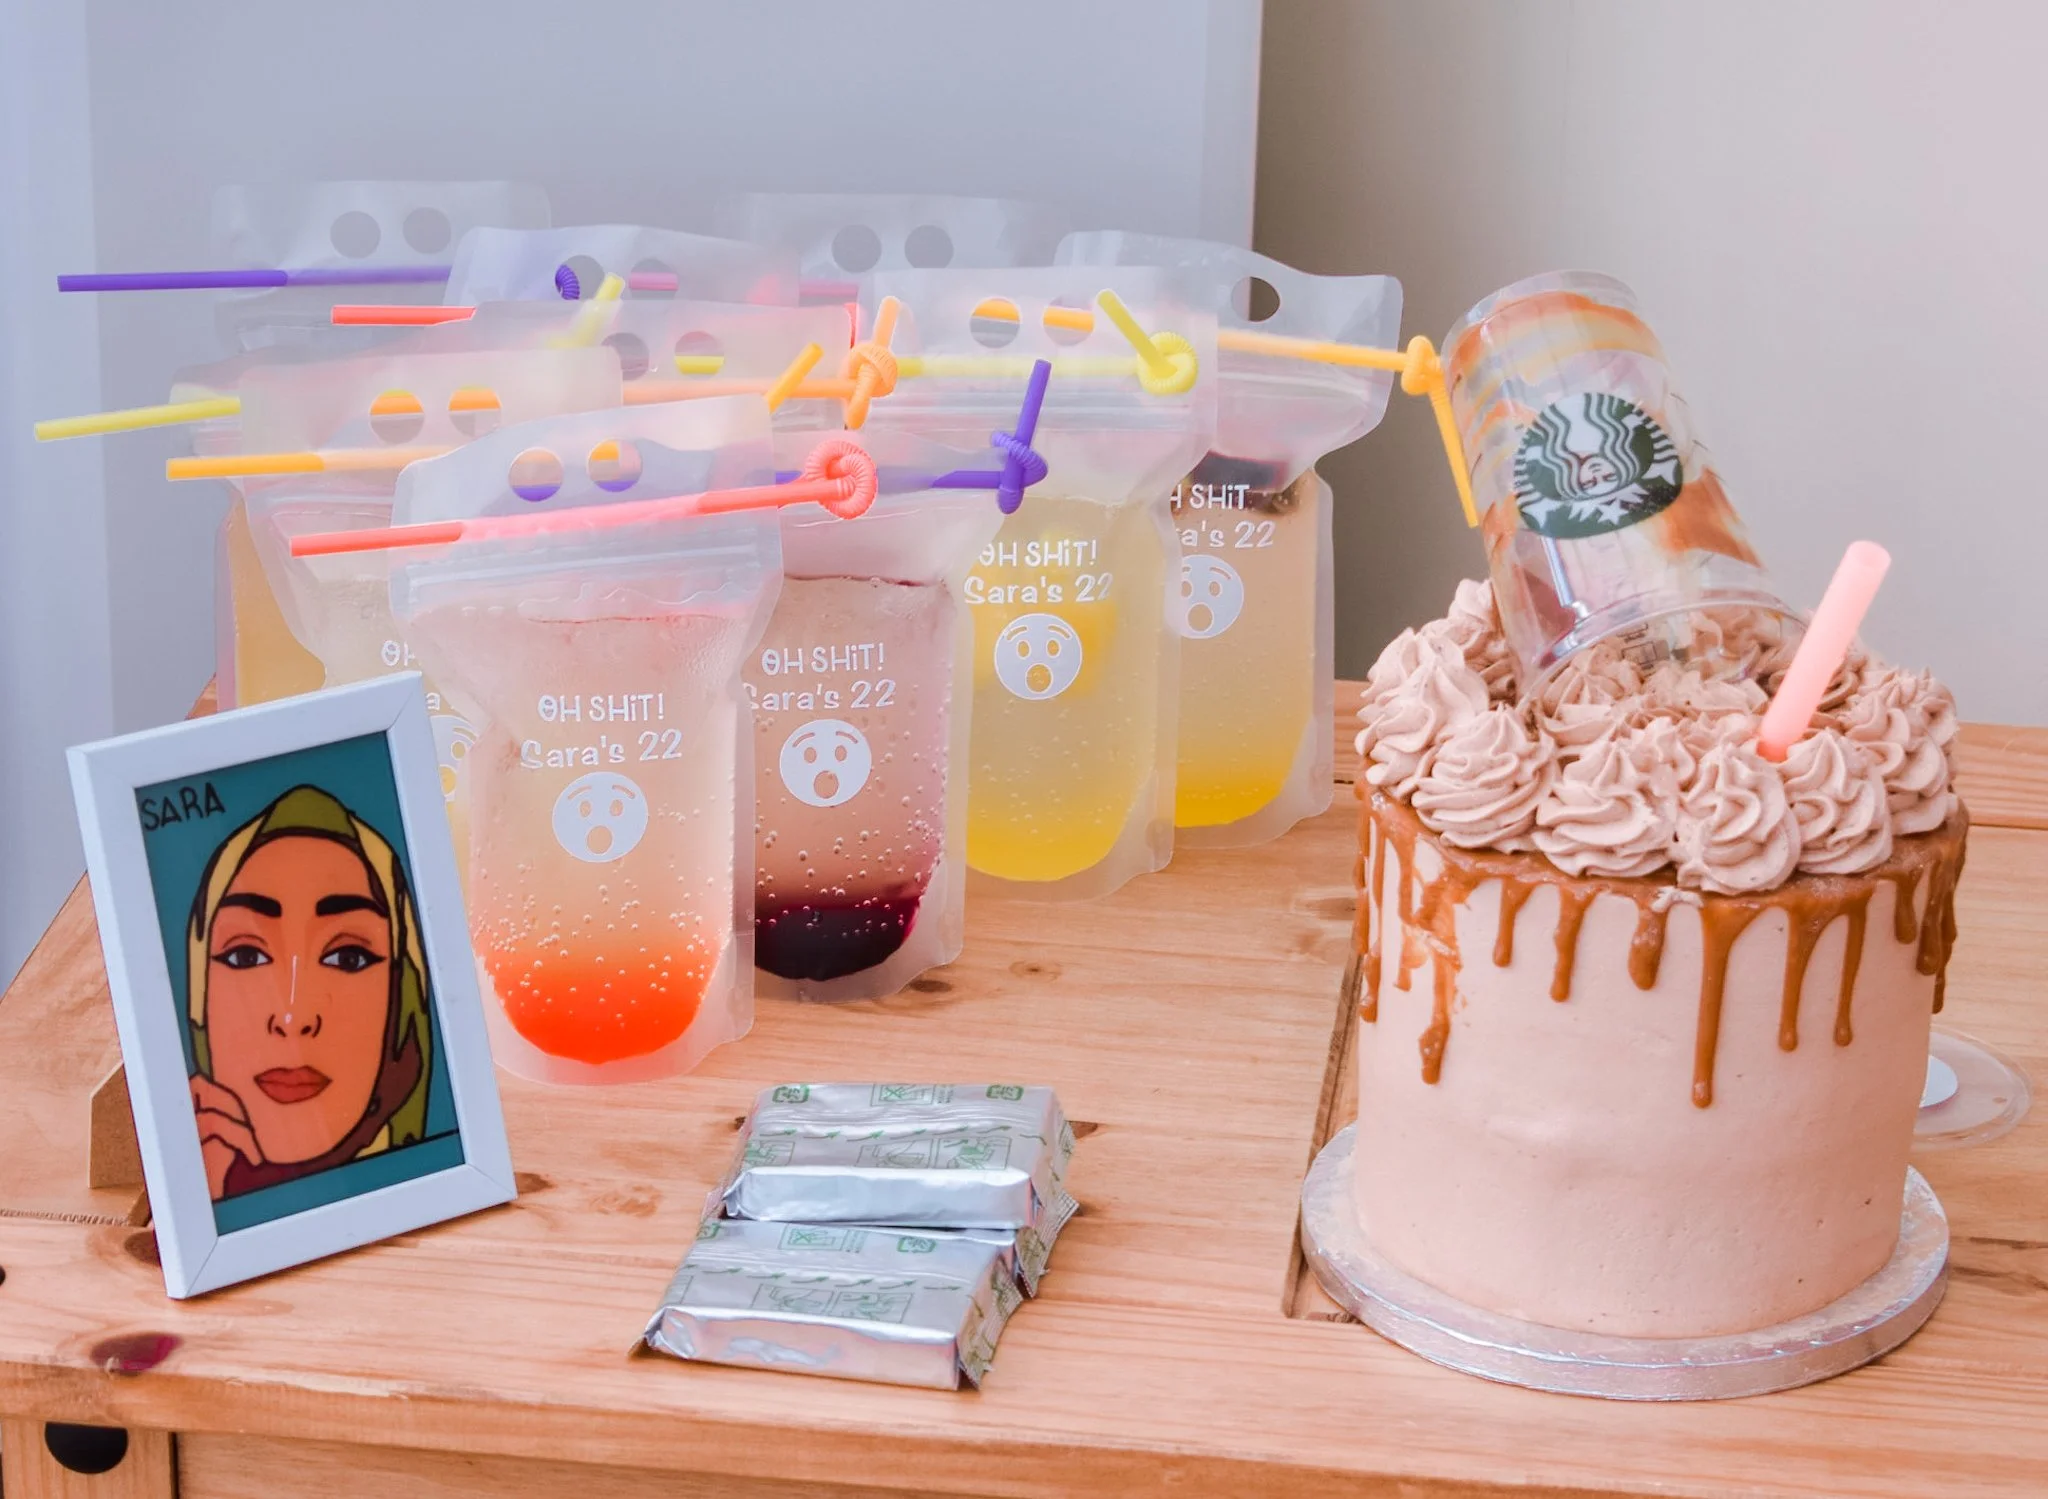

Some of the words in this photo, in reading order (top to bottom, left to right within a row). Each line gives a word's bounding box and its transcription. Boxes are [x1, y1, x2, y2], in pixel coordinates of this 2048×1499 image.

[1234, 520, 1275, 548] 22
[979, 541, 1017, 567] OH
[1024, 539, 1096, 567] SHiT!
[963, 575, 1063, 604] Sara's
[1075, 572, 1113, 602] 22
[761, 647, 804, 675] OH
[811, 642, 884, 672] SHiT!
[538, 694, 581, 723] OH
[589, 692, 664, 722] SHiT!
[742, 682, 840, 711] Sara's
[851, 678, 896, 709] 22
[520, 735, 626, 769] Sara's
[638, 729, 682, 761] 22
[141, 781, 227, 832] SARA
